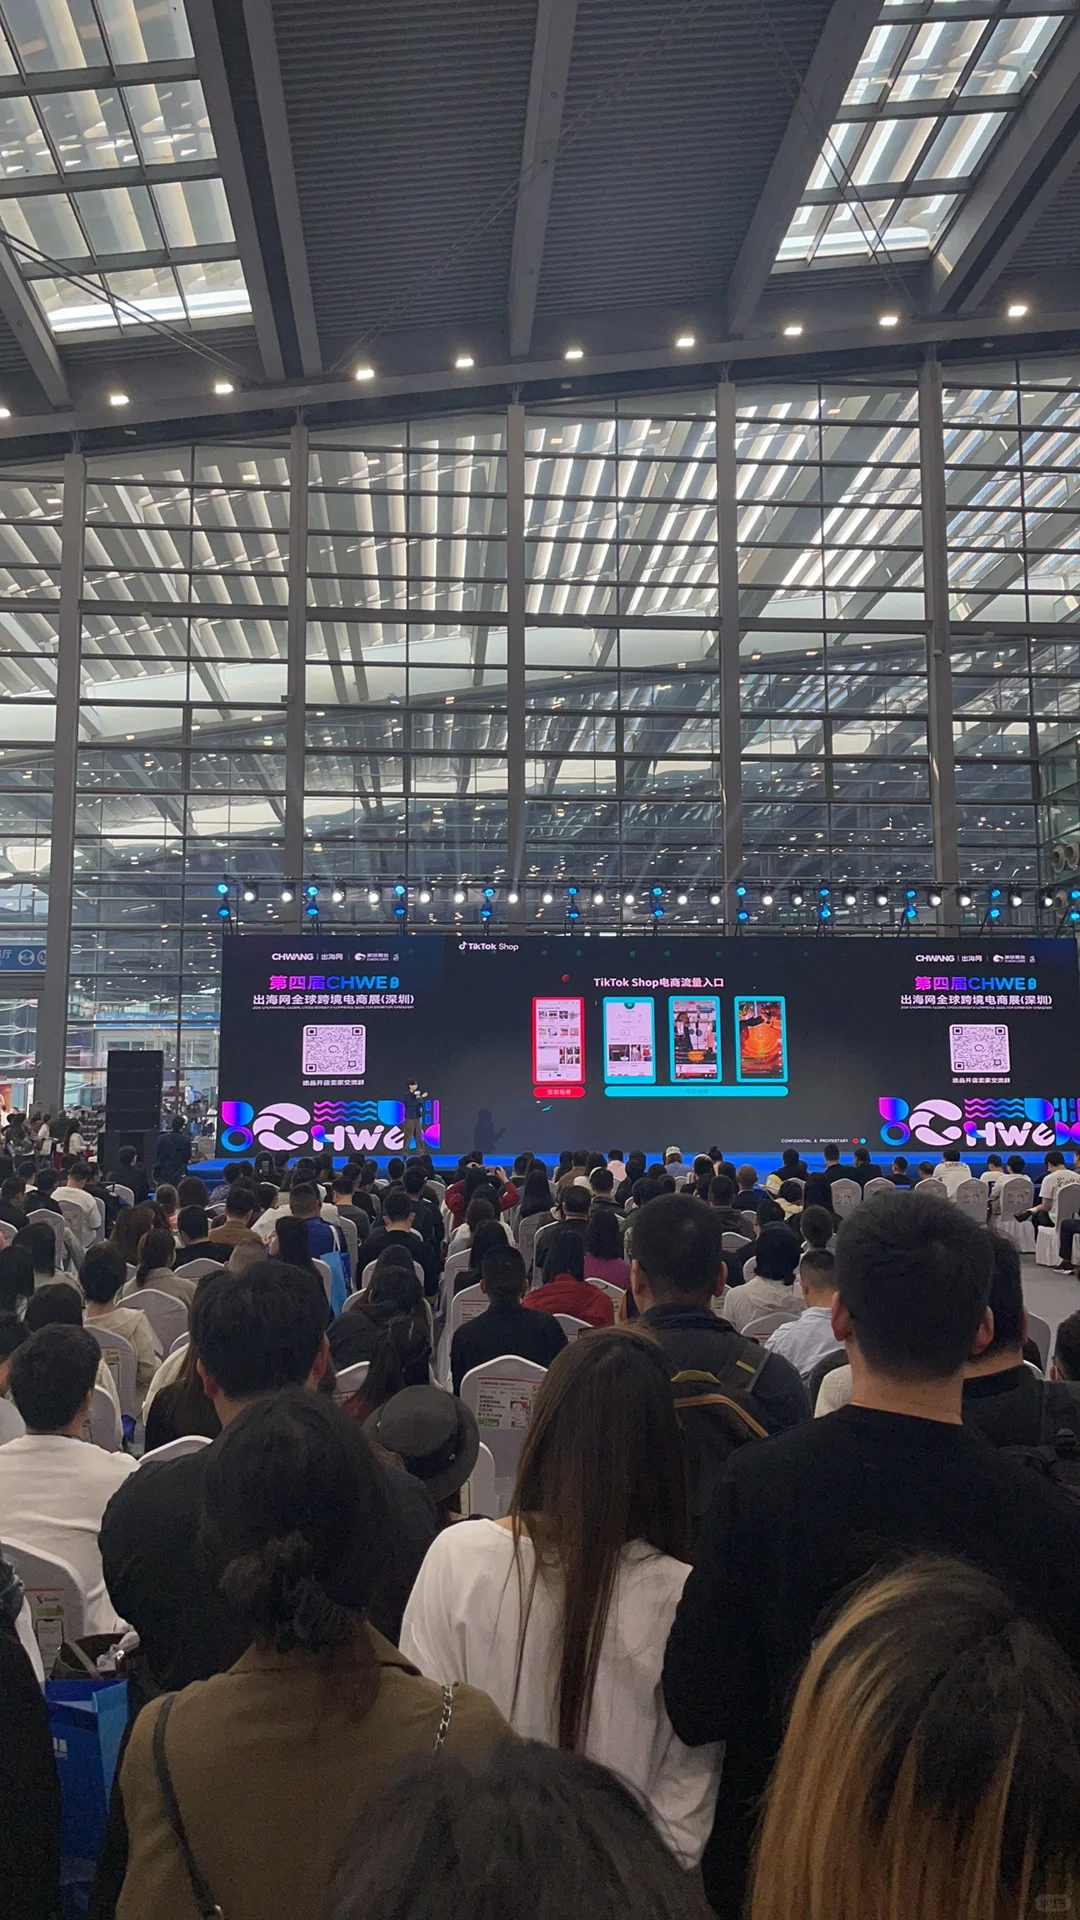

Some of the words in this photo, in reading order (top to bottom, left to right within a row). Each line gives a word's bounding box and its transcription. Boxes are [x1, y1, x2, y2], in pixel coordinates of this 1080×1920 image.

[498, 943, 519, 951] Shop
[0, 949, 12, 960] 厅
[271, 953, 314, 961] CHWANG
[321, 953, 344, 961] 出海网
[915, 954, 955, 962] CHWANG
[594, 978, 629, 987] TikTok
[631, 977, 724, 988] Shop电商流量入口
[253, 994, 415, 1005] 出海网全球跨境电商展(深圳)
[901, 994, 1052, 1005] 出海网全球跨境电商展(深圳)
